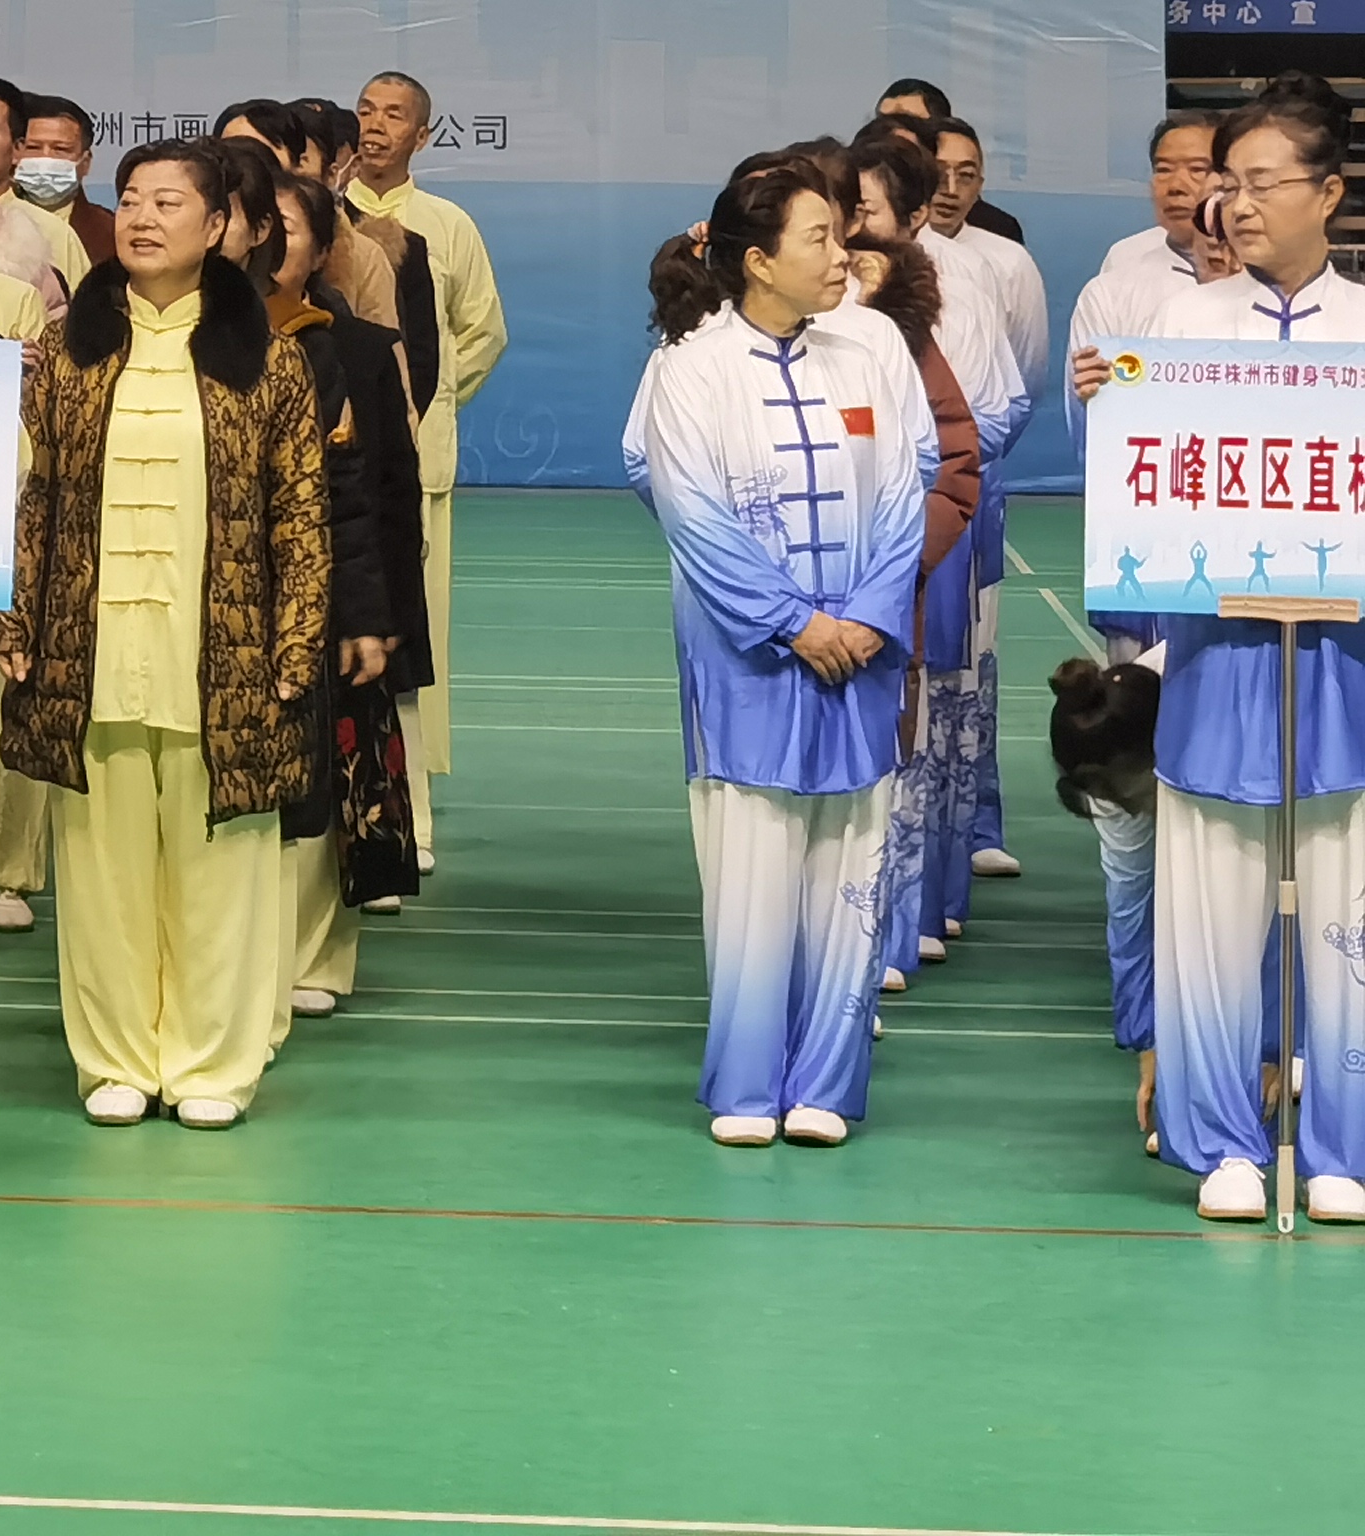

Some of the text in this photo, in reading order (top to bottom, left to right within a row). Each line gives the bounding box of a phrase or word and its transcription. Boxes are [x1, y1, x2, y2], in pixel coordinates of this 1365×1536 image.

[1151, 362, 1365, 389] 2020年株洲市健身气功
